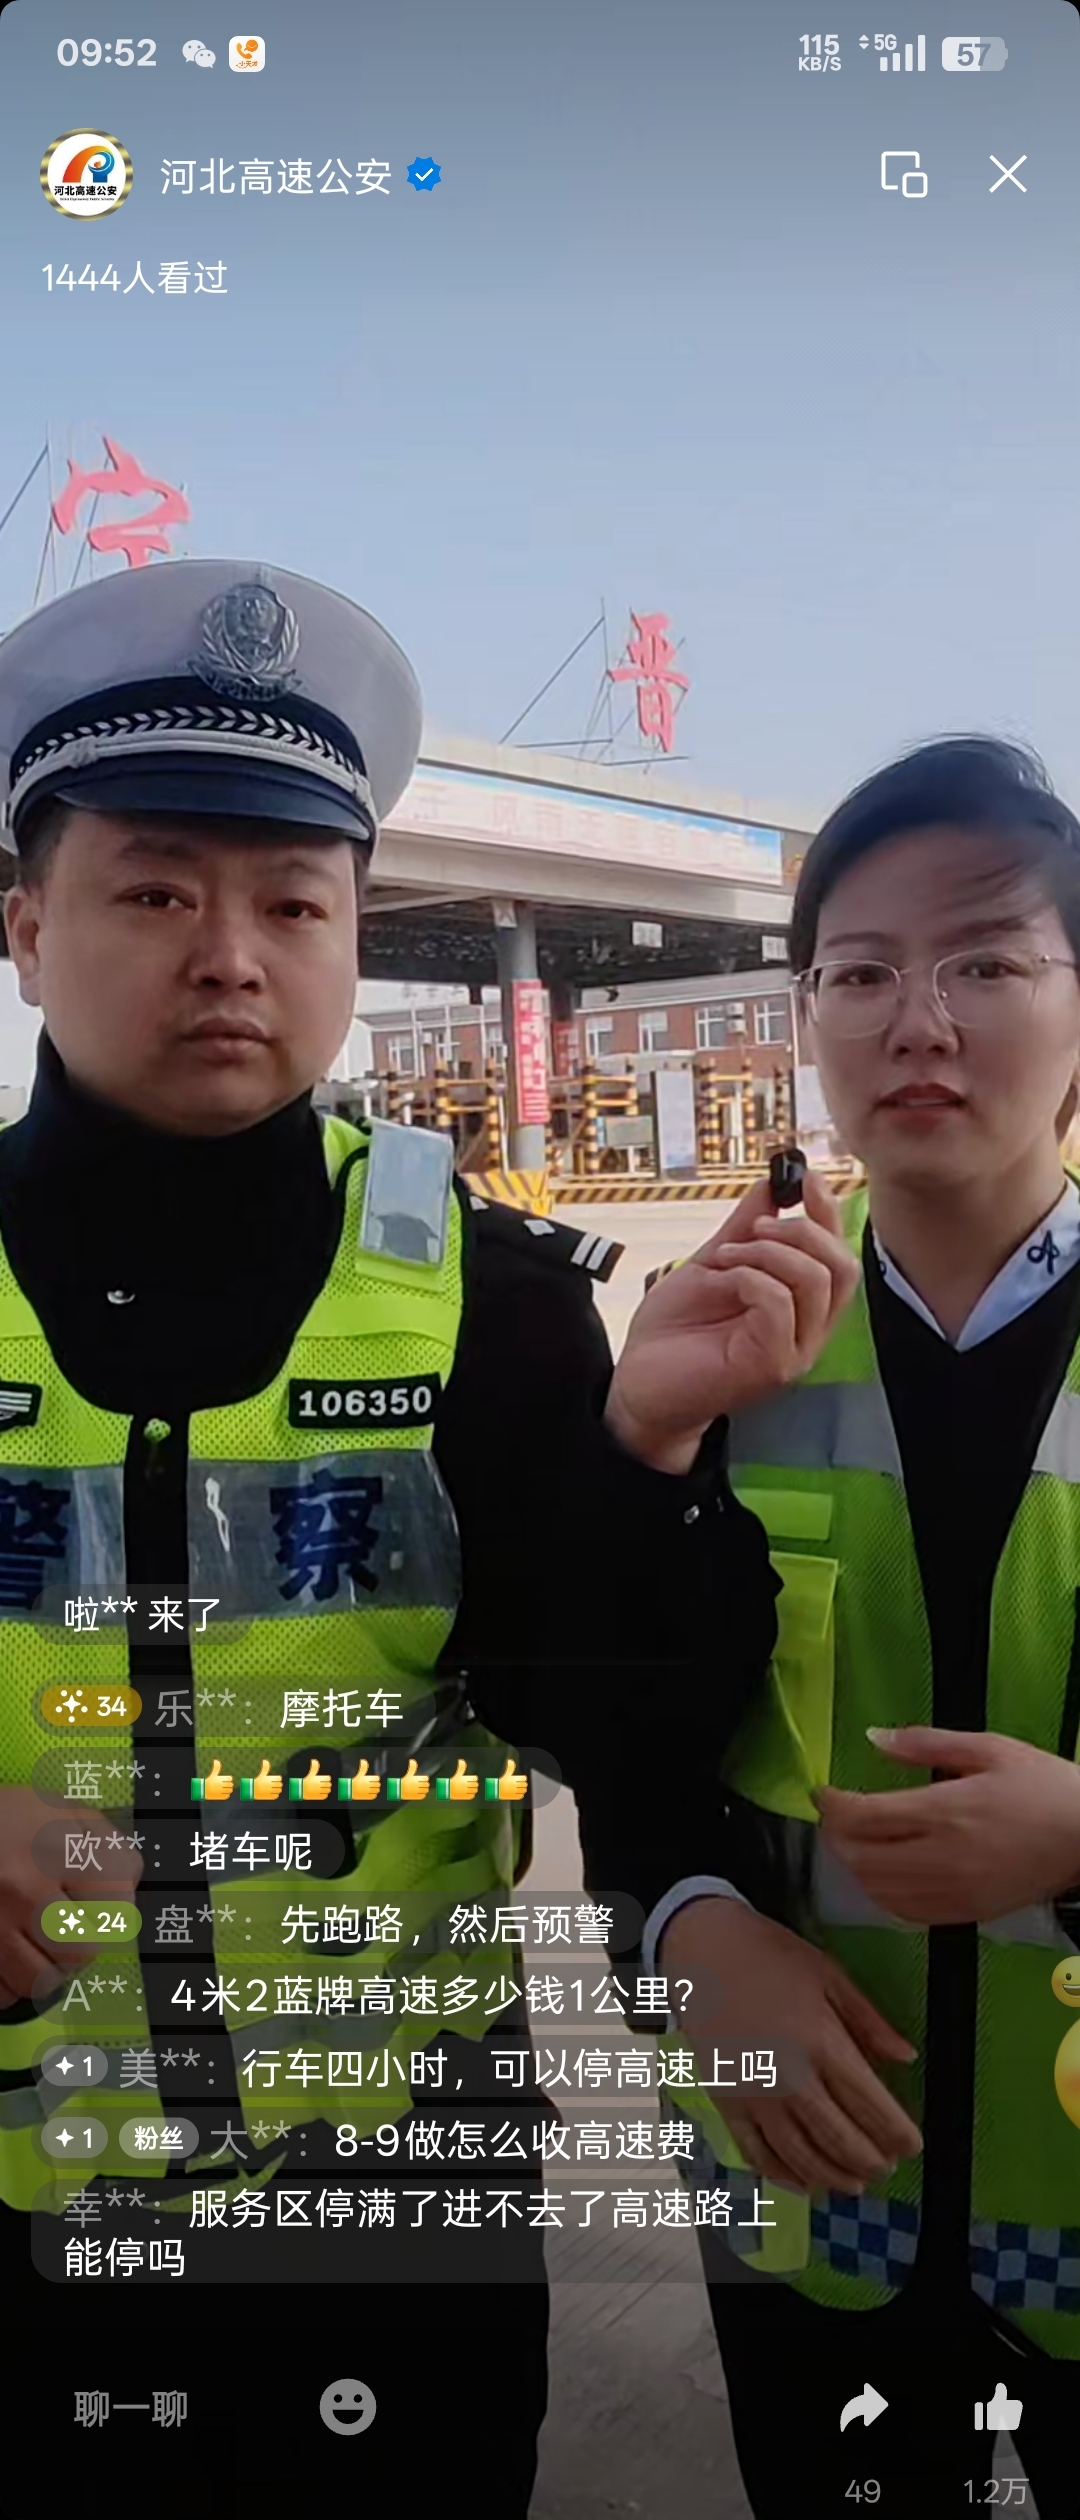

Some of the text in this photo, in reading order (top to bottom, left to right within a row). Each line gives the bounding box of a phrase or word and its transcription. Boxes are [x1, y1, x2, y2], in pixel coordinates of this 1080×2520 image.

[607, 606, 691, 754] 晋
[298, 1386, 434, 1418] 106350
[269, 1468, 383, 1601] 察
